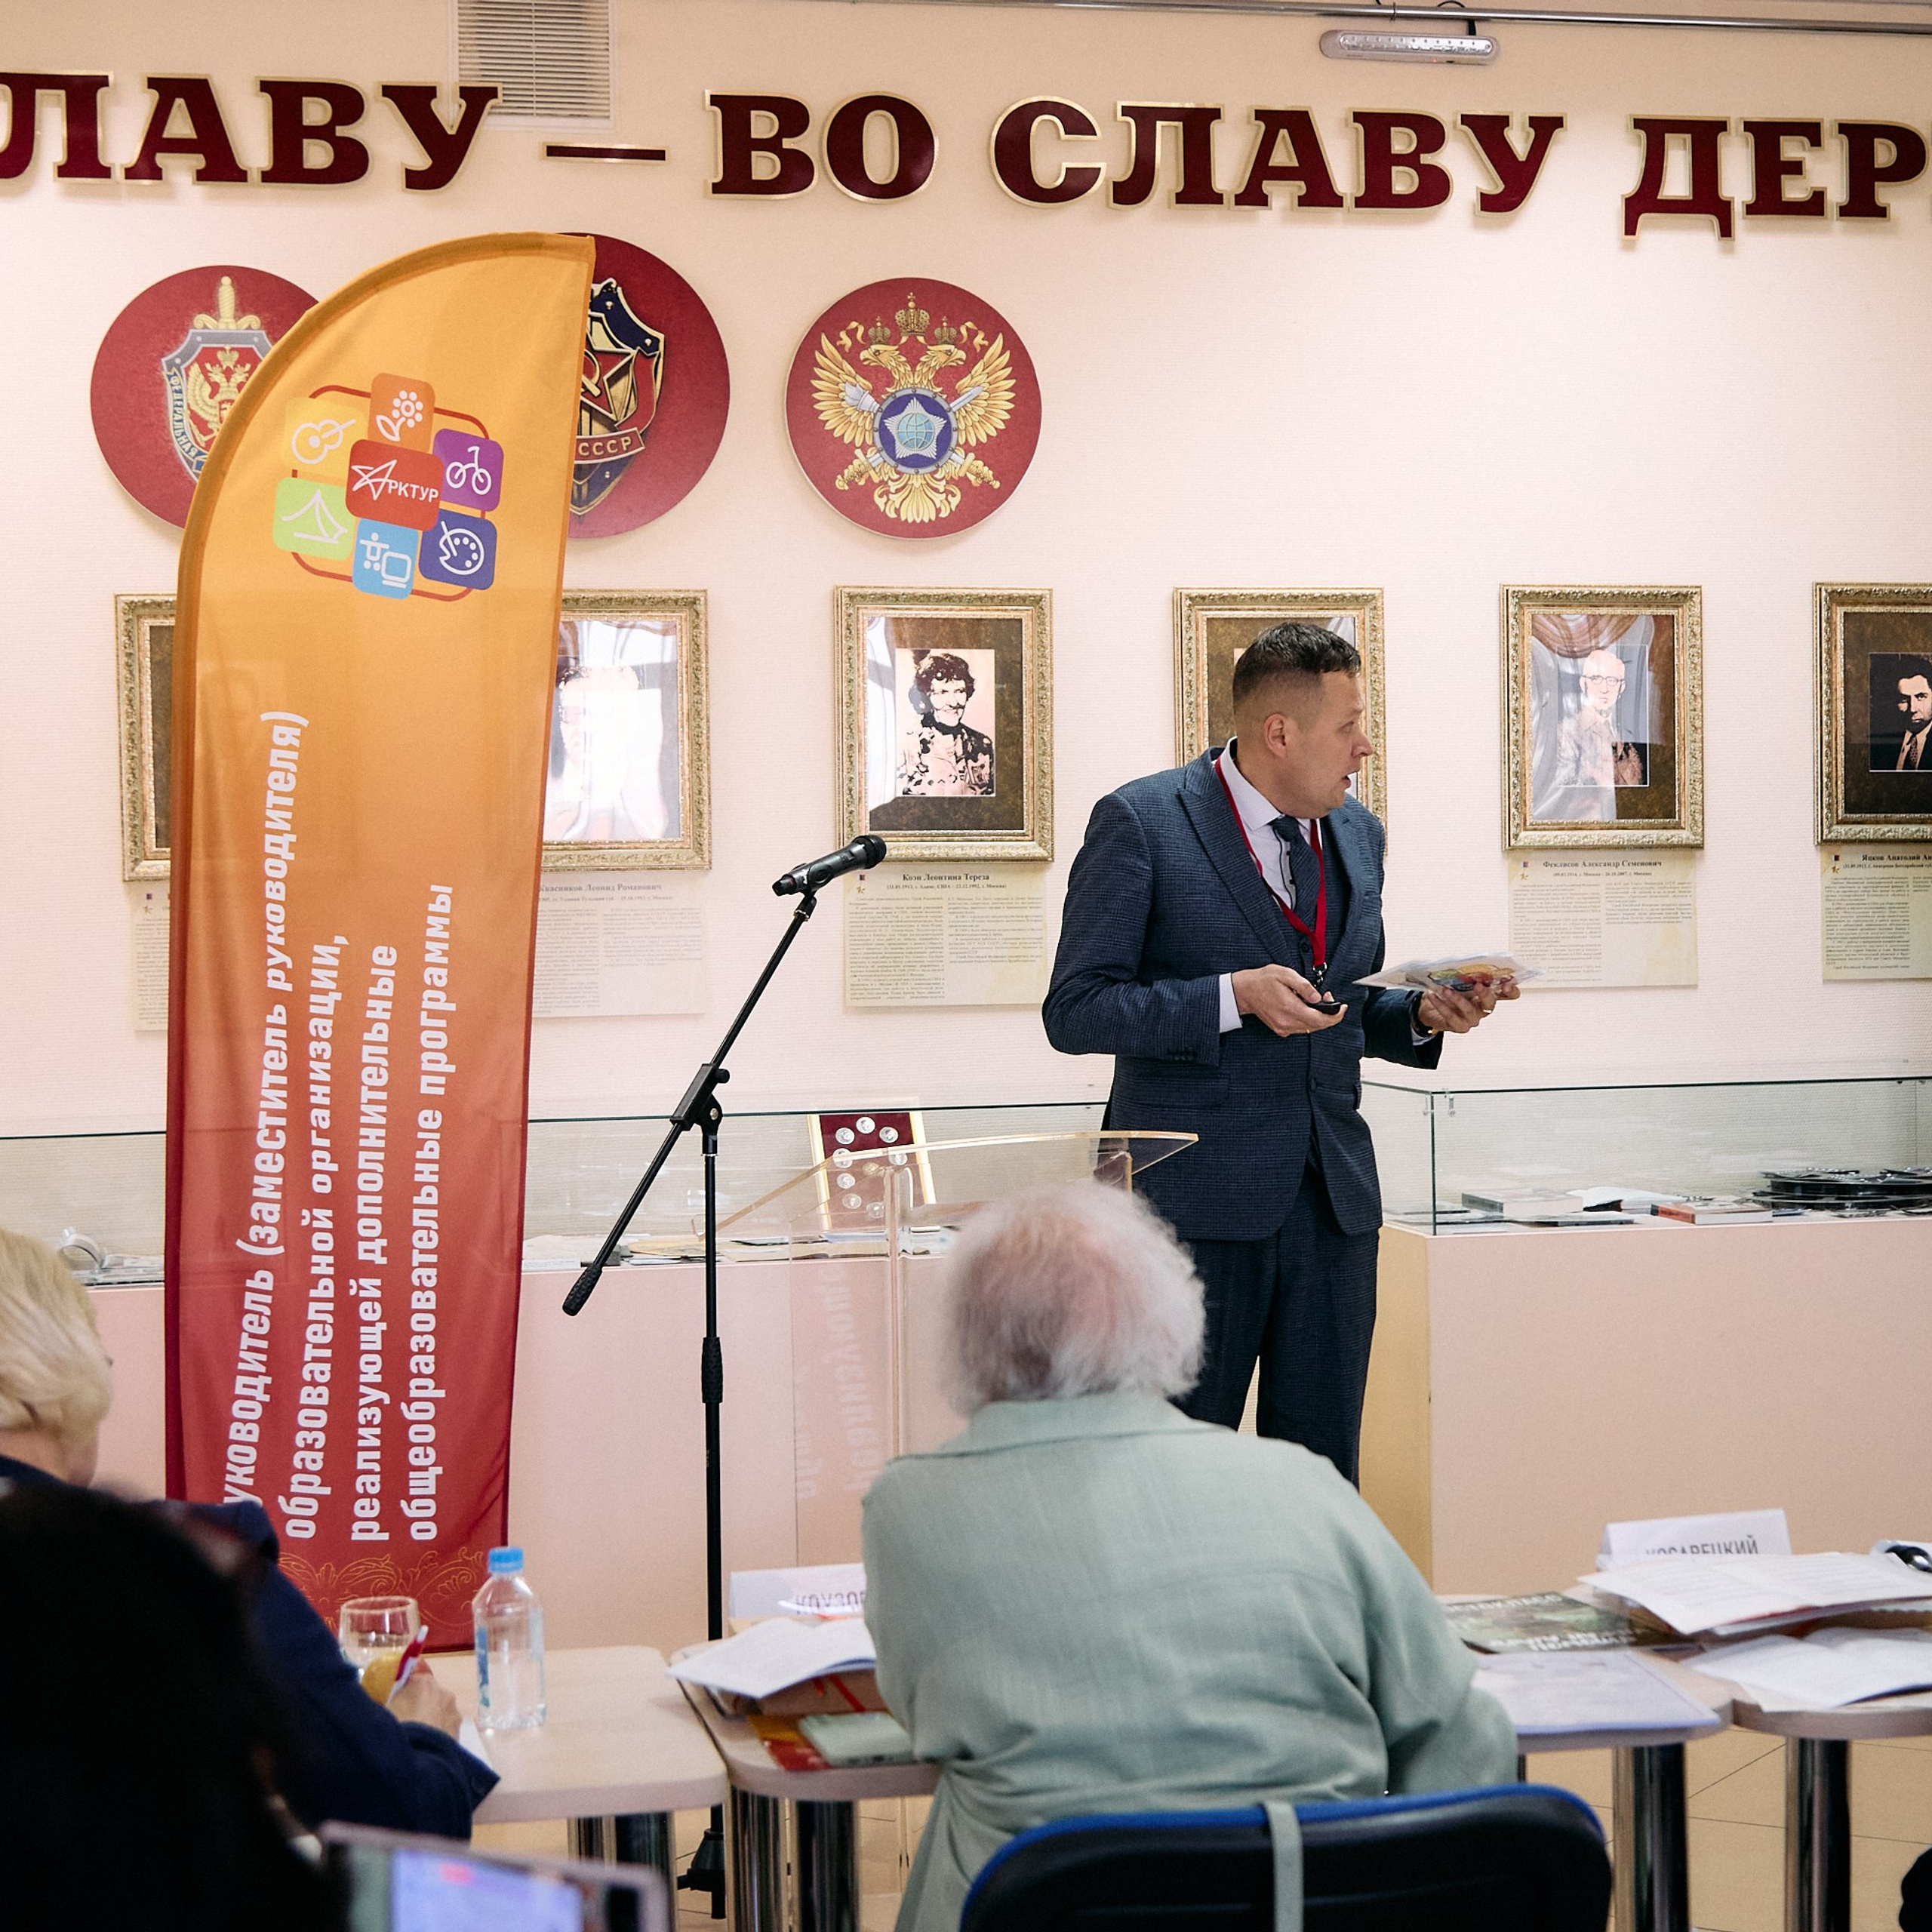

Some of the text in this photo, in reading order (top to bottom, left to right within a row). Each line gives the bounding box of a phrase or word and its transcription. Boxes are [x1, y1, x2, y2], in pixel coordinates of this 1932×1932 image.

[577, 436, 632, 457] СССР
[703, 90, 940, 205] ВО
[990, 95, 1567, 218] СЛАВУ
[1620, 113, 1930, 241] ДЕР
[223, 711, 309, 1506] уководитель (заместитель руководителя)
[277, 935, 349, 1539] образовательной организации,
[349, 946, 397, 1541] реализующей дополнительные
[400, 884, 457, 1540] общеобразовательные программы
